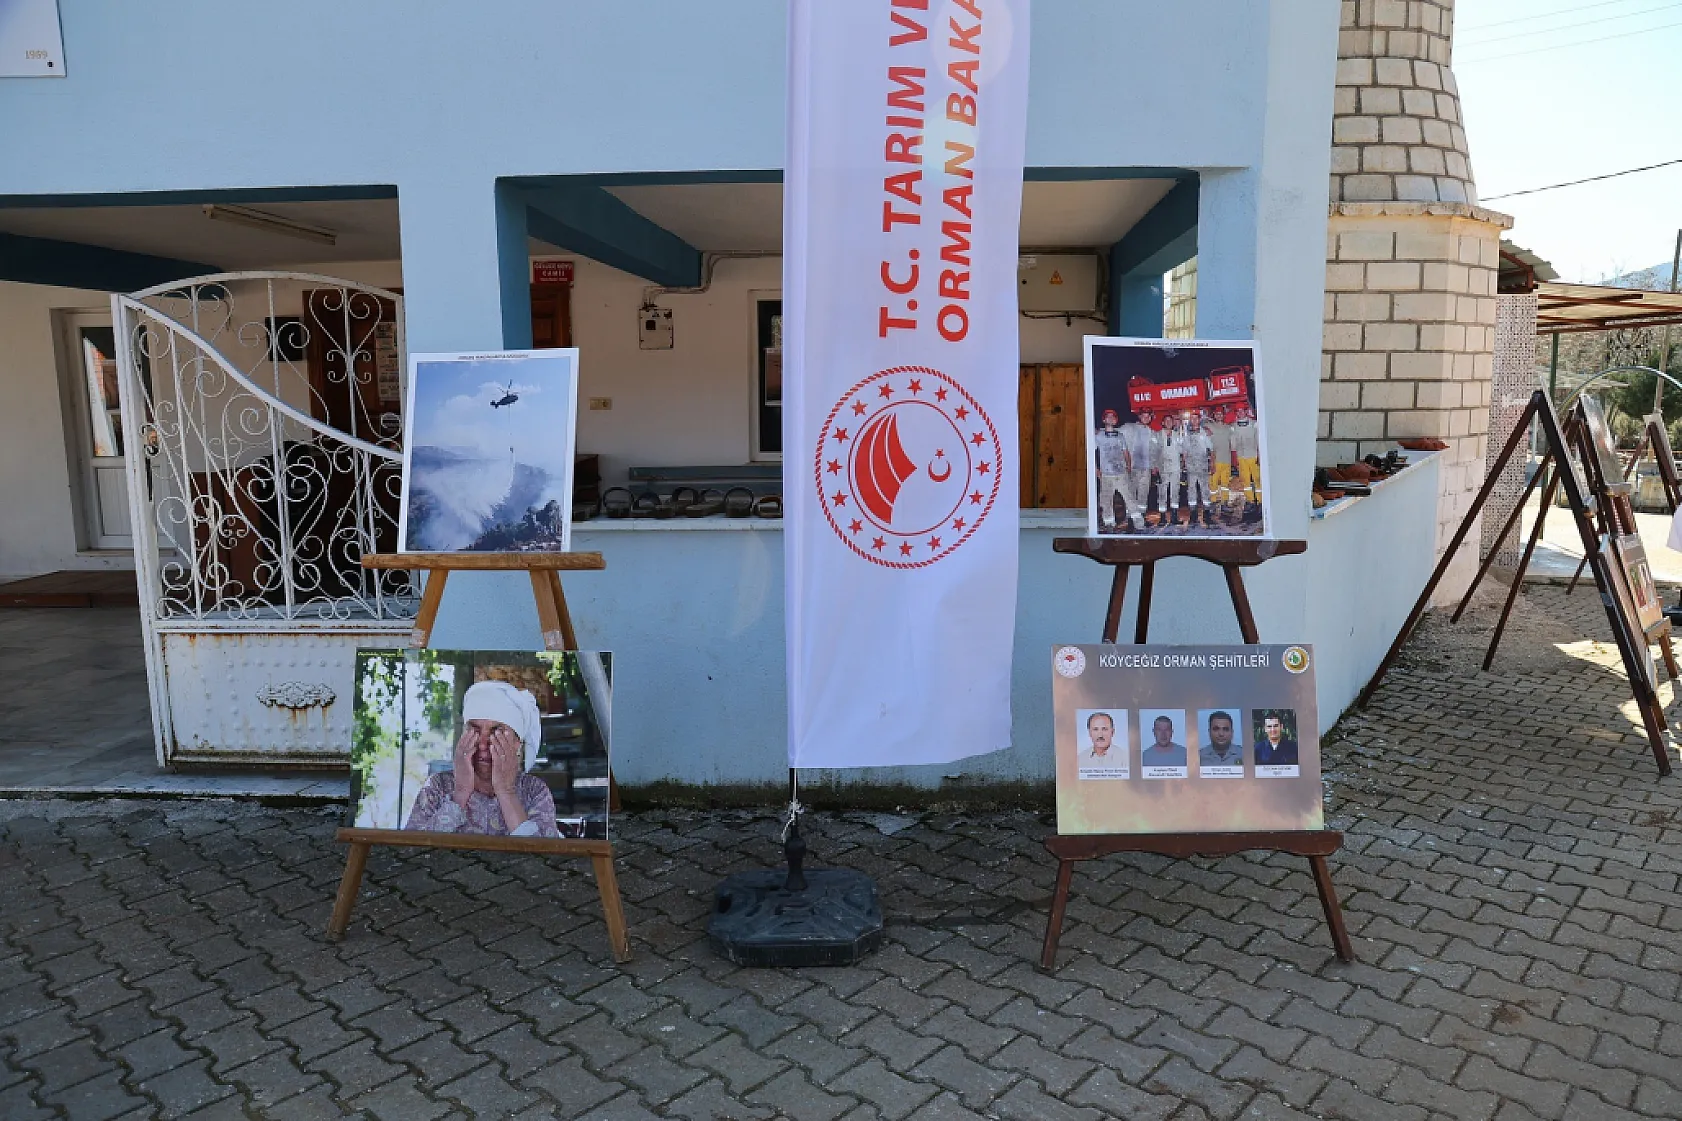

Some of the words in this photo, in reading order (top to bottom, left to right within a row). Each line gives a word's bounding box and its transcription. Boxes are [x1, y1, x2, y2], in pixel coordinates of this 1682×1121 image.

[882, 66, 927, 233] TARIM
[879, 249, 921, 338] T.C.
[936, 140, 976, 343] ORMAN
[1163, 654, 1206, 668] ORMAN
